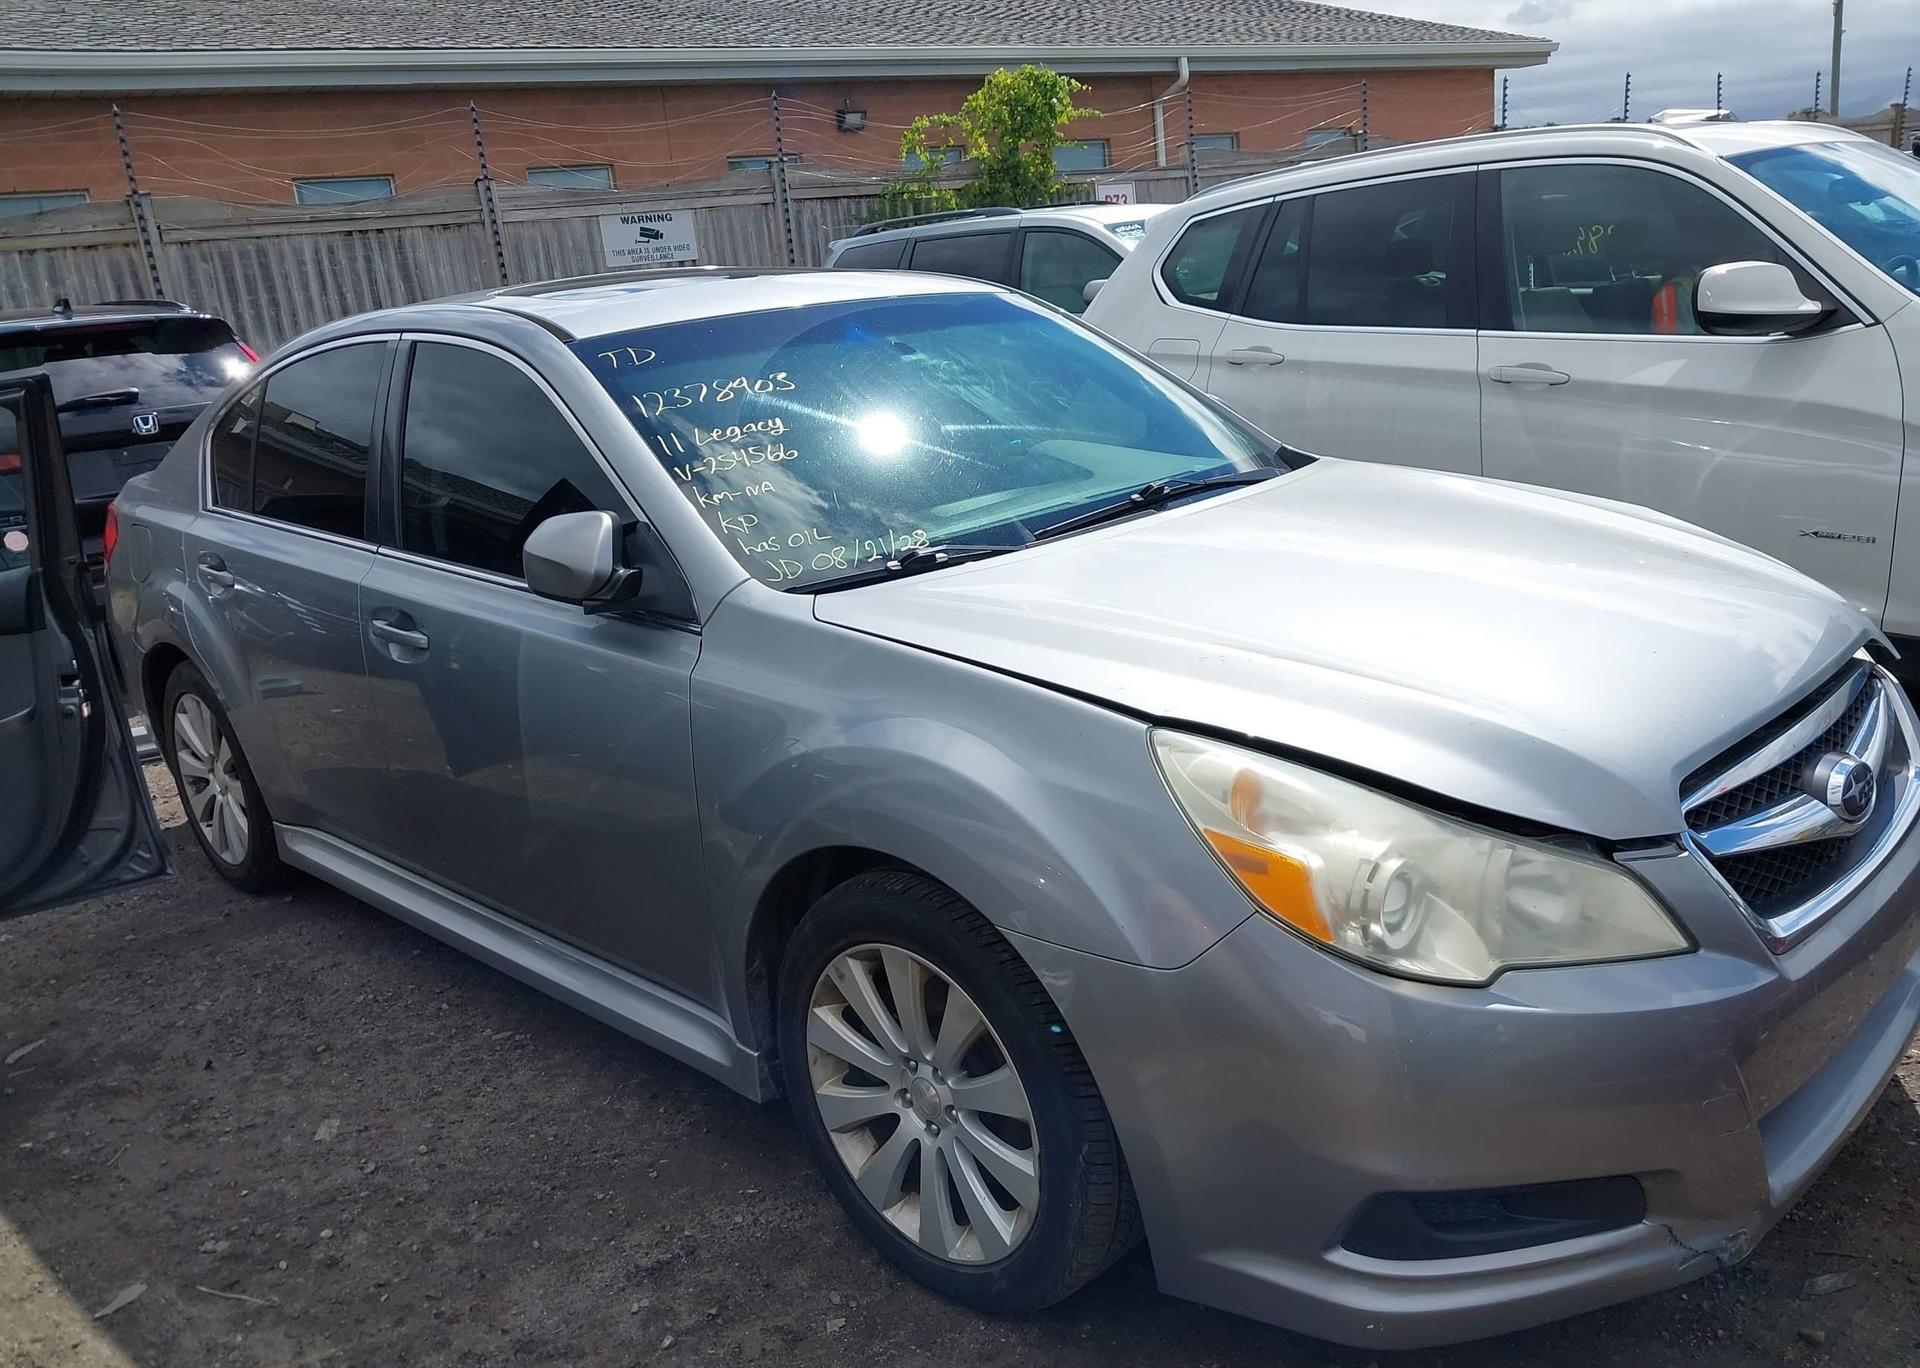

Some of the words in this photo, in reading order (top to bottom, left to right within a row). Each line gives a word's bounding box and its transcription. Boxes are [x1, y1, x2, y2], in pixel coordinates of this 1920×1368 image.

[620, 213, 673, 225] WARNING
[627, 247, 643, 256] AREA
[644, 246, 651, 254] IS
[651, 245, 672, 253] UNDER
[673, 243, 691, 252] VIDEO
[631, 253, 675, 263] SURVEILLANCE
[632, 371, 796, 418] 12378903
[694, 417, 790, 446] Legacy
[738, 537, 780, 556] has
[764, 558, 803, 582] JD
